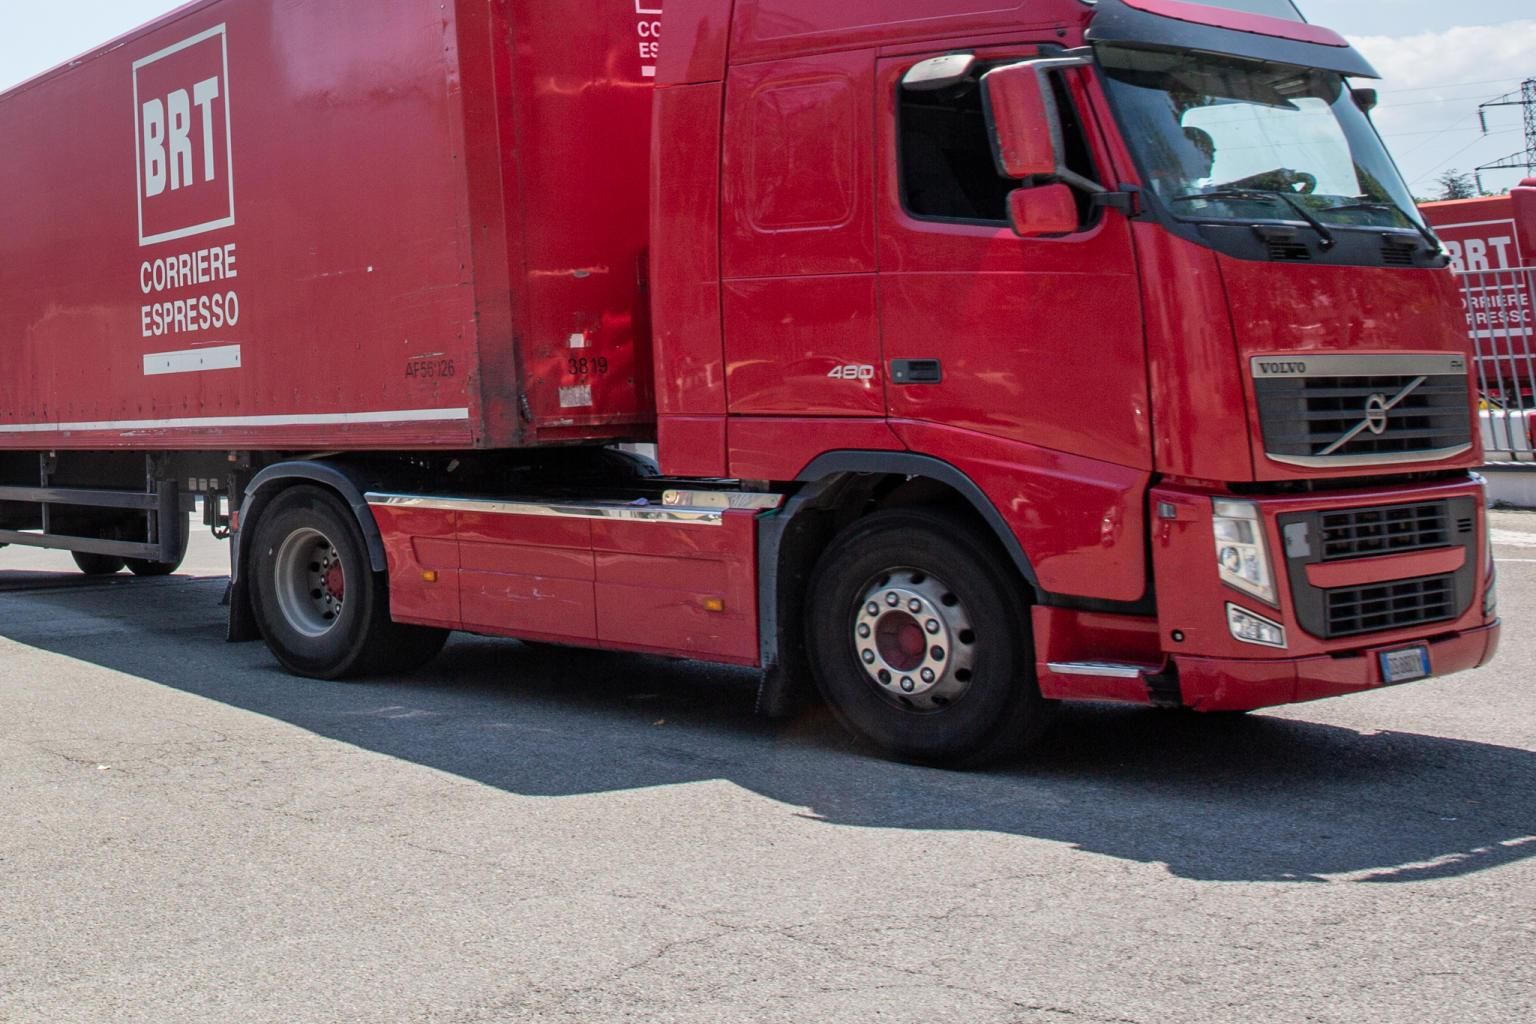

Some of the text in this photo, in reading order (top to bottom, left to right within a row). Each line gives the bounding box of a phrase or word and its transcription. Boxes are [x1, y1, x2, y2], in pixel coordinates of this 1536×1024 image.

[143, 76, 219, 197] BRT
[140, 243, 237, 294] CORRIERE
[1461, 293, 1528, 308] RRIERE
[142, 291, 238, 337] ESPRESSO
[1466, 309, 1531, 325] PRESSO
[568, 357, 608, 374] 3819
[827, 365, 874, 379] 480
[1259, 362, 1306, 374] VOLVO
